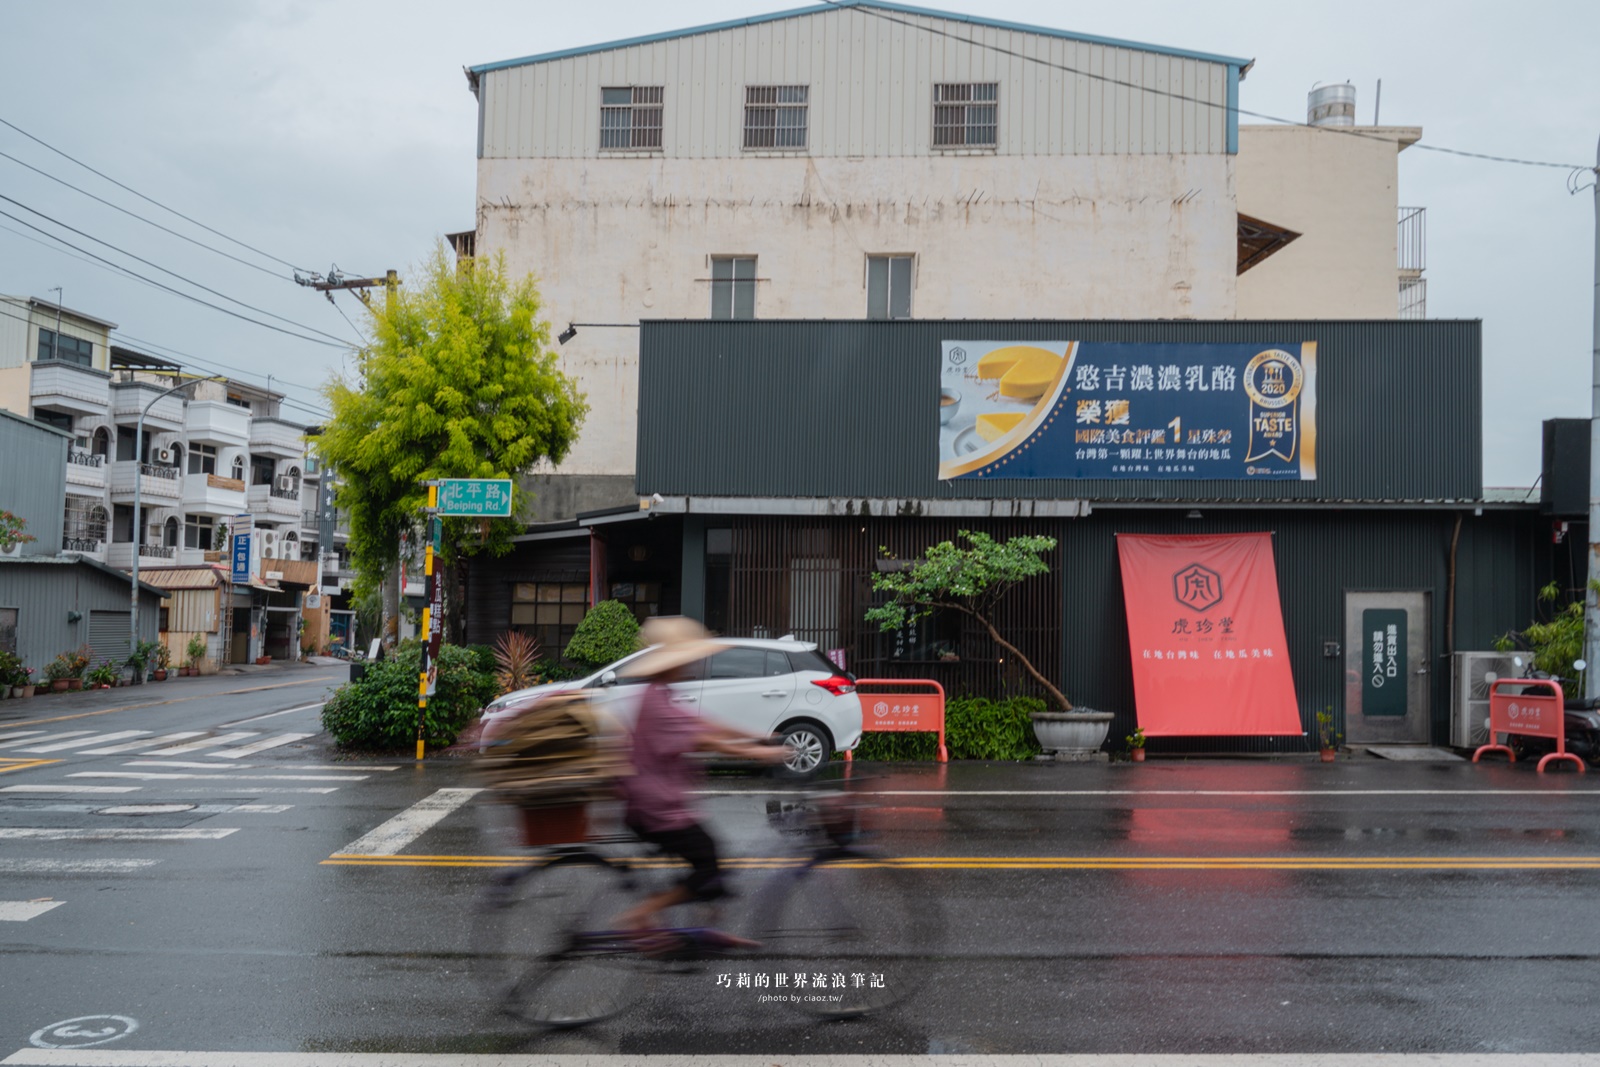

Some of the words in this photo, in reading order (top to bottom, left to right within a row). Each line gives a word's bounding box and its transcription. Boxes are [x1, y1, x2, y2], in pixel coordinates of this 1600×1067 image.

[1075, 364, 1237, 392] 憨吉濃濃乳酪
[1261, 384, 1286, 394] 2020
[1076, 399, 1130, 425] 榮獲
[1254, 418, 1292, 432] TASTE
[1075, 447, 1231, 461] 台灣第一顆躍上世界舞台的地瓜
[448, 483, 501, 499] 北平路
[447, 500, 482, 512] Beiping
[485, 500, 501, 511] Rd.
[1171, 617, 1235, 634] 虎珍堂
[1143, 649, 1199, 660] 在地台灣味
[1214, 648, 1274, 660] 在地瓜美味
[1372, 631, 1383, 674] 請勿進入
[1386, 624, 1397, 678] 進貨出入口
